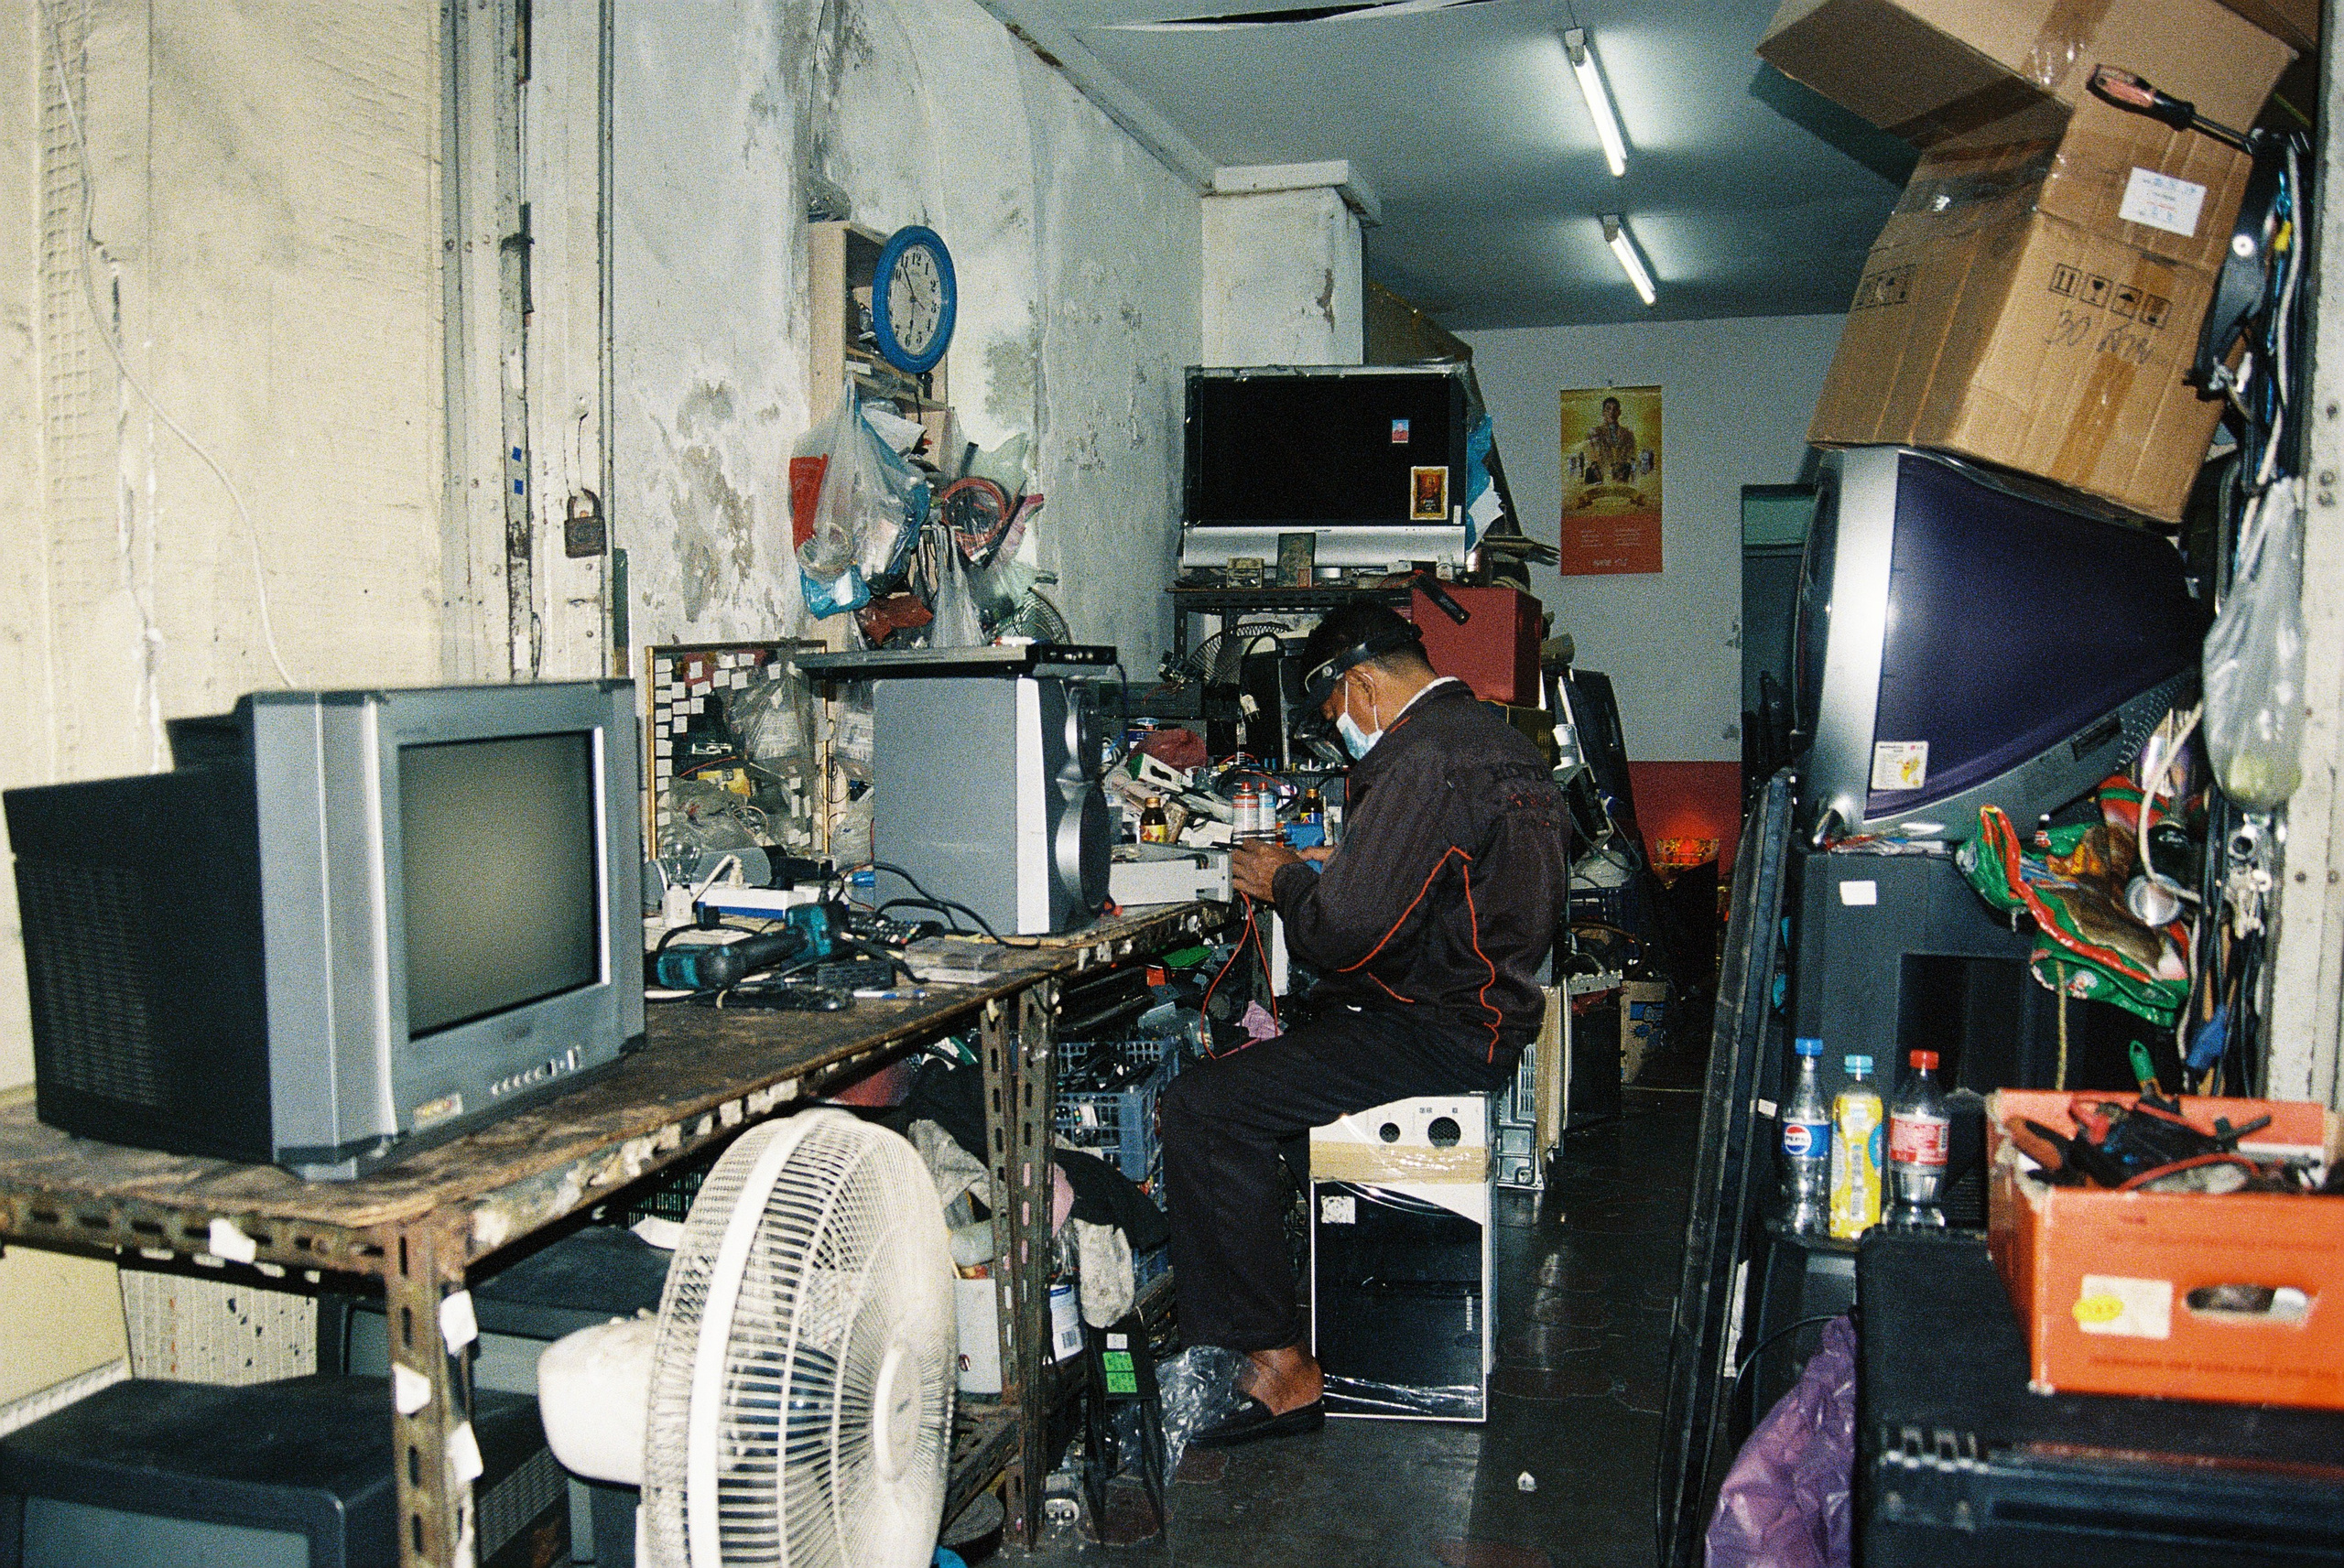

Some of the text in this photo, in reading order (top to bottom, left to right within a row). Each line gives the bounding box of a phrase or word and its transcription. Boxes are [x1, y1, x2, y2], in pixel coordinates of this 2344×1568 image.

[901, 254, 909, 268] 11
[912, 253, 922, 266] 12
[930, 280, 936, 292] 2
[930, 302, 937, 313] 3
[905, 334, 911, 347] 6
[916, 331, 922, 344] 5
